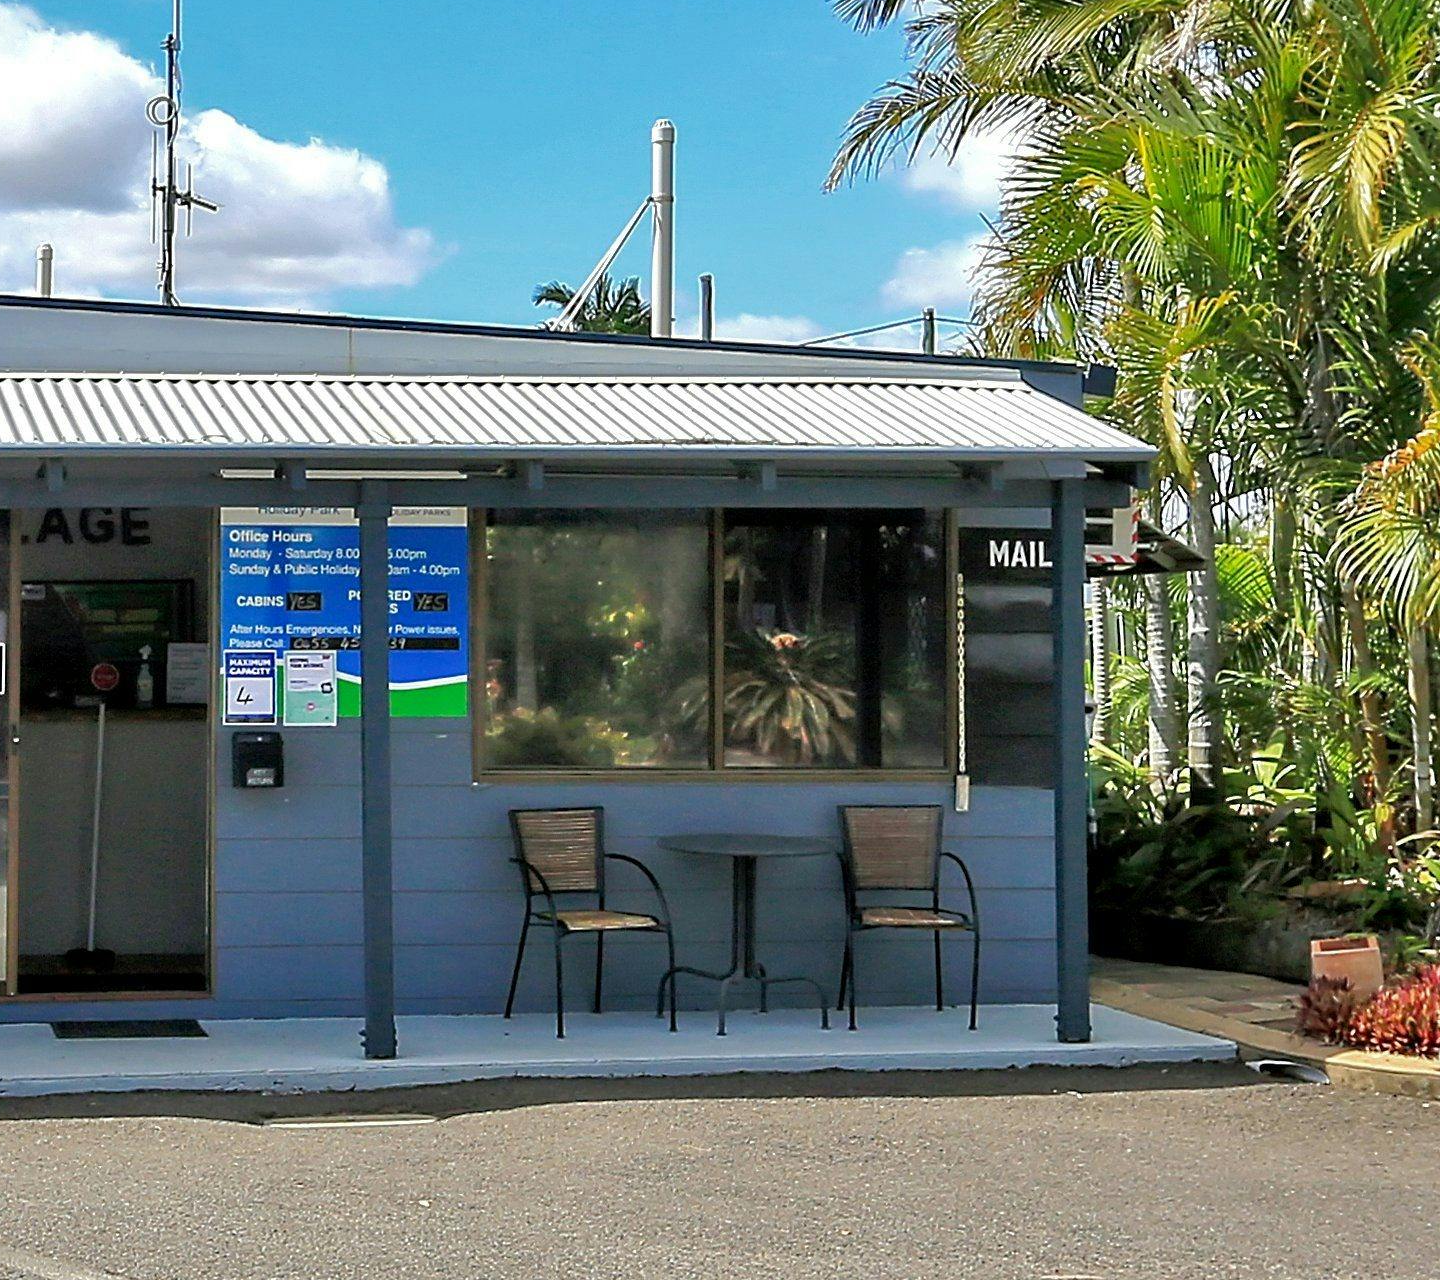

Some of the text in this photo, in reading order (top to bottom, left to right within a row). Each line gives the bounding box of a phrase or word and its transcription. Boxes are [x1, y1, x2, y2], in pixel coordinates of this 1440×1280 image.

[21, 507, 152, 545] AGE
[229, 529, 313, 542] Office Hours
[229, 547, 272, 561] Monday
[285, 547, 334, 561] Saturday
[989, 540, 1054, 568] MAIL
[229, 563, 271, 577] Sunday
[273, 564, 282, 575] &
[284, 564, 319, 575] Public
[419, 564, 460, 578] 4.00pm
[236, 593, 317, 611] CABINS YES
[416, 593, 446, 611] YES
[229, 624, 253, 635] After
[255, 624, 284, 635] Hours
[395, 624, 425, 635] Power
[229, 638, 262, 649] Please
[229, 658, 272, 667] MAXIMUM
[229, 667, 272, 676] CAPACITY
[236, 686, 254, 705] 4
